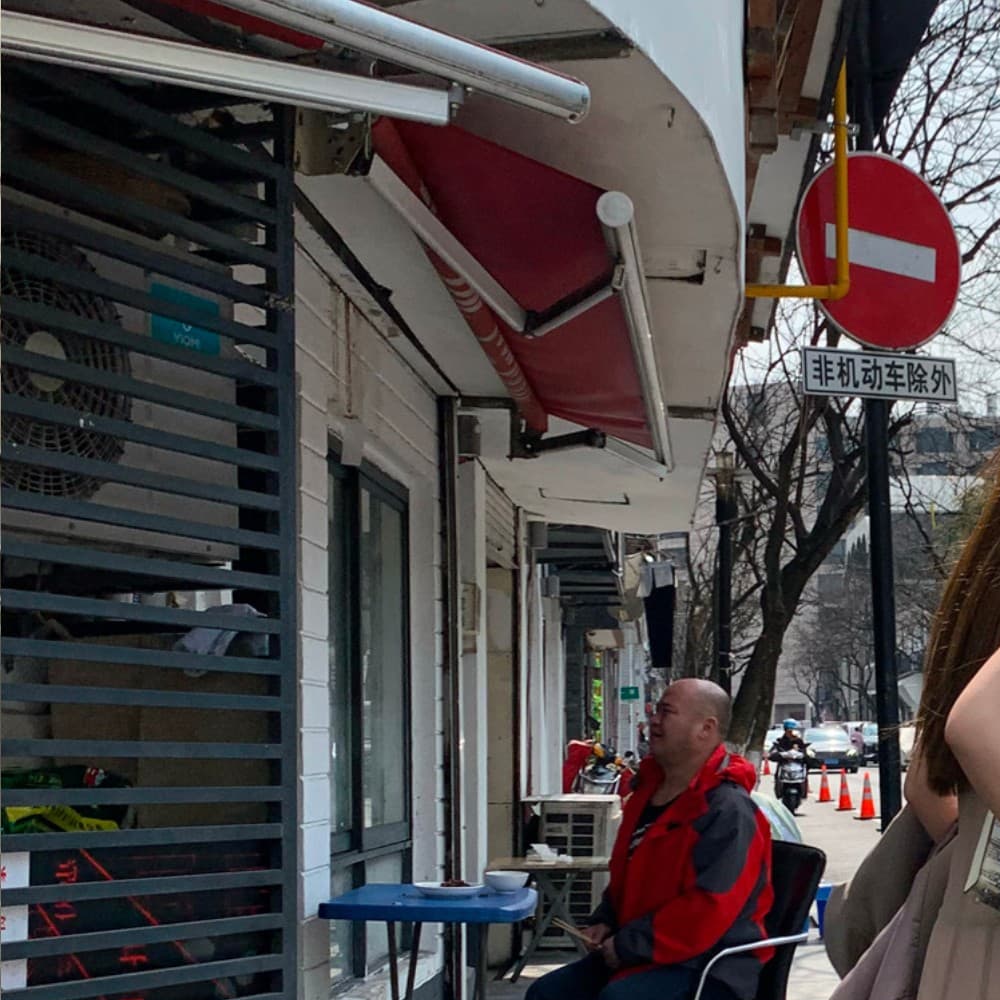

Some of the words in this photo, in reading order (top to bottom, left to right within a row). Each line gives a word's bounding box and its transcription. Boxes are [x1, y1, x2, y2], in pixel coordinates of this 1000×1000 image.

[812, 354, 952, 395] 非机动车除外
